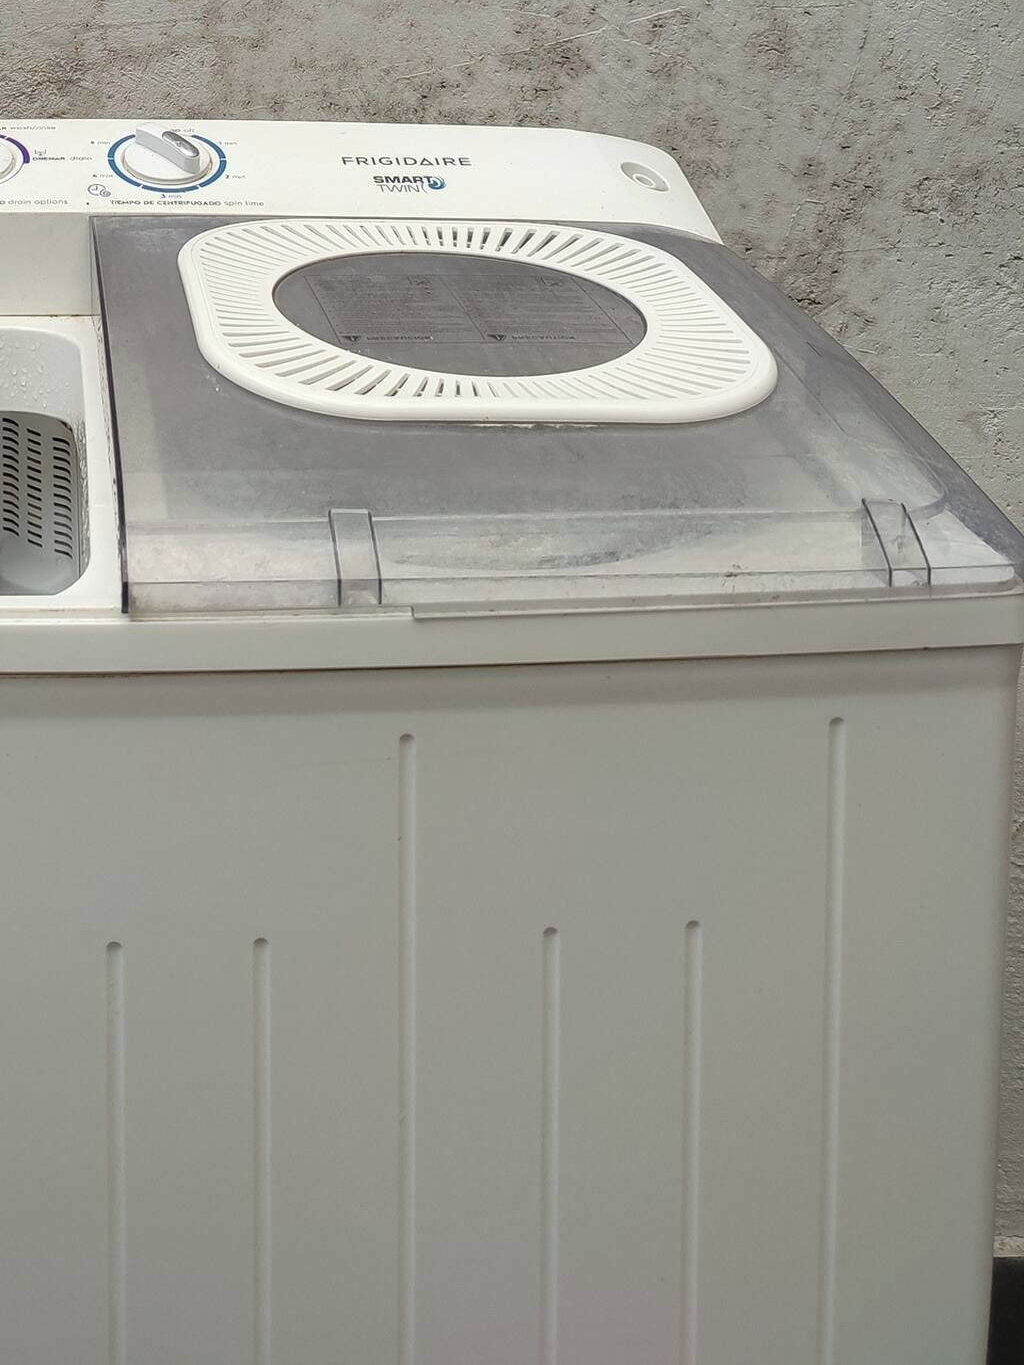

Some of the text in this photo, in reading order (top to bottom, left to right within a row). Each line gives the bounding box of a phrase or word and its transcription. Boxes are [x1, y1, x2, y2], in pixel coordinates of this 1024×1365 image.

[341, 156, 473, 166] FRIGIDAIRE
[373, 175, 433, 184] SMART
[377, 184, 422, 193] TWIN
